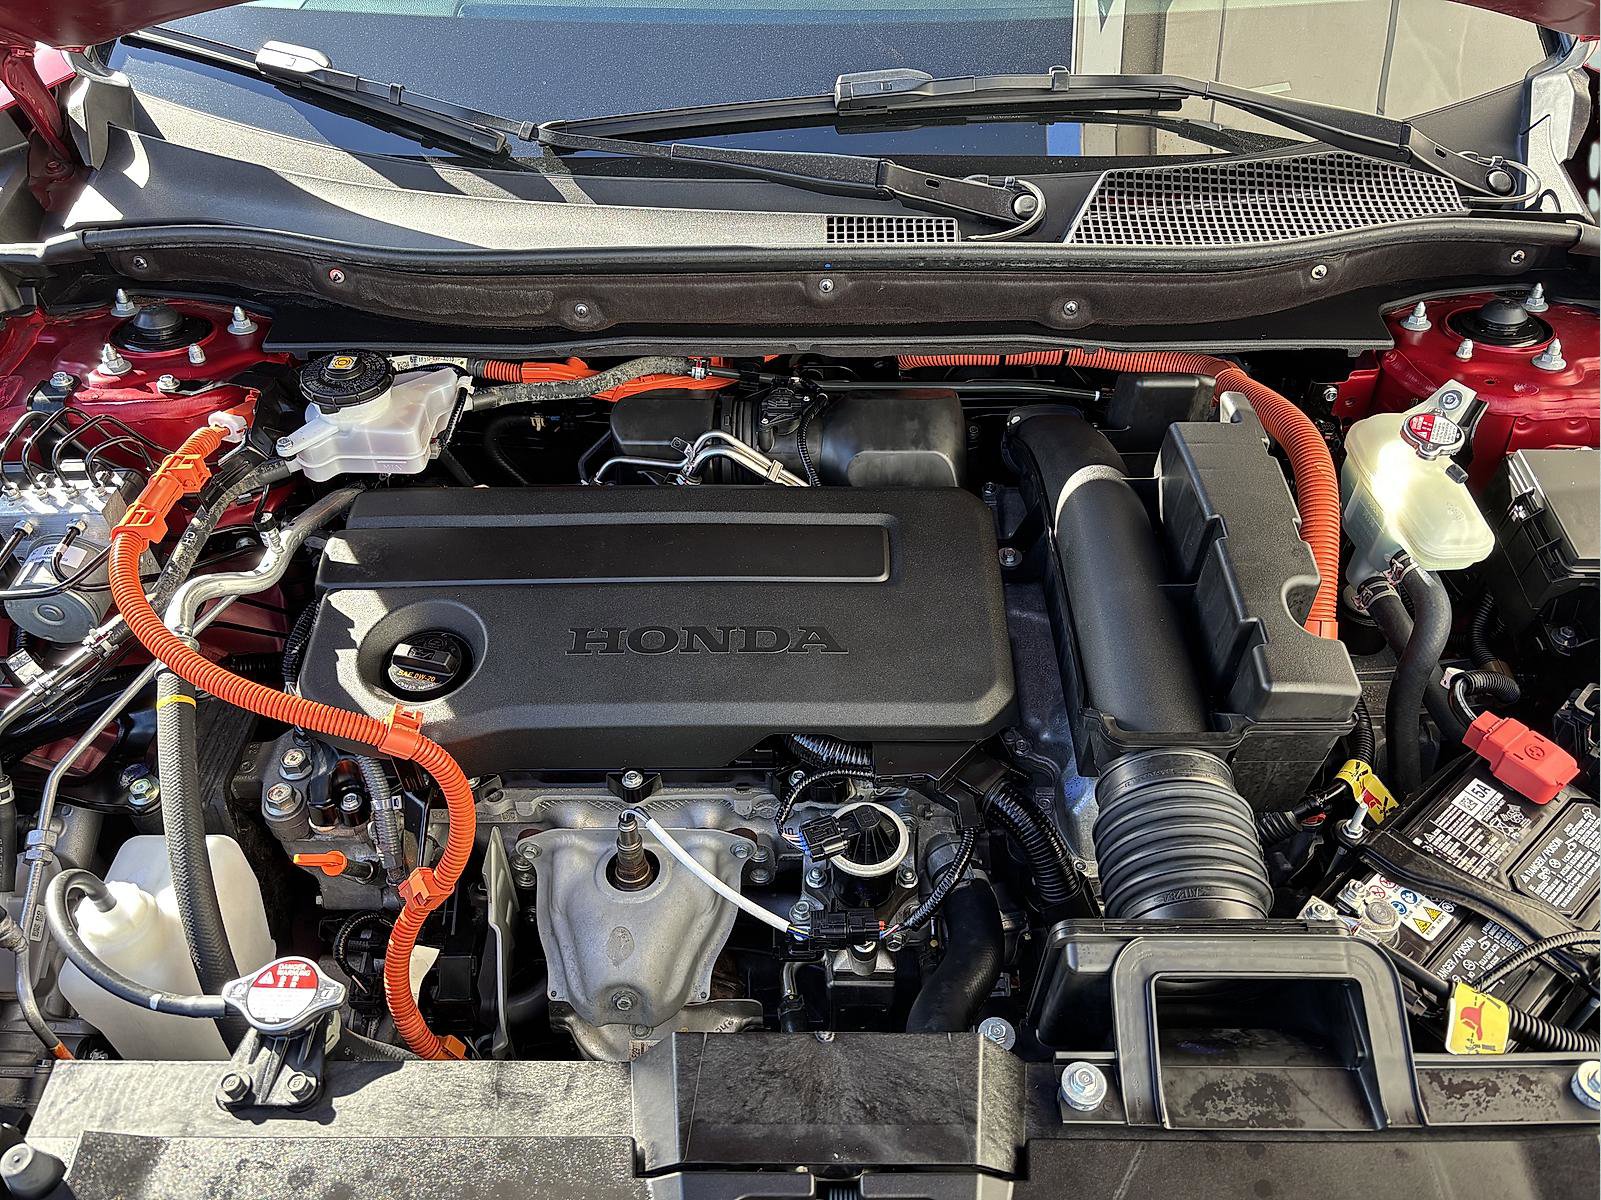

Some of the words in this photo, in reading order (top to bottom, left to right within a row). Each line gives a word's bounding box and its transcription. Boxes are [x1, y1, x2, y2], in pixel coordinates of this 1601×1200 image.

[565, 626, 849, 656] HONDA
[397, 669, 413, 678] SAE
[413, 672, 436, 682] 0W-20
[1471, 784, 1491, 798] 5A
[1436, 936, 1477, 980] ANGER/POISON
